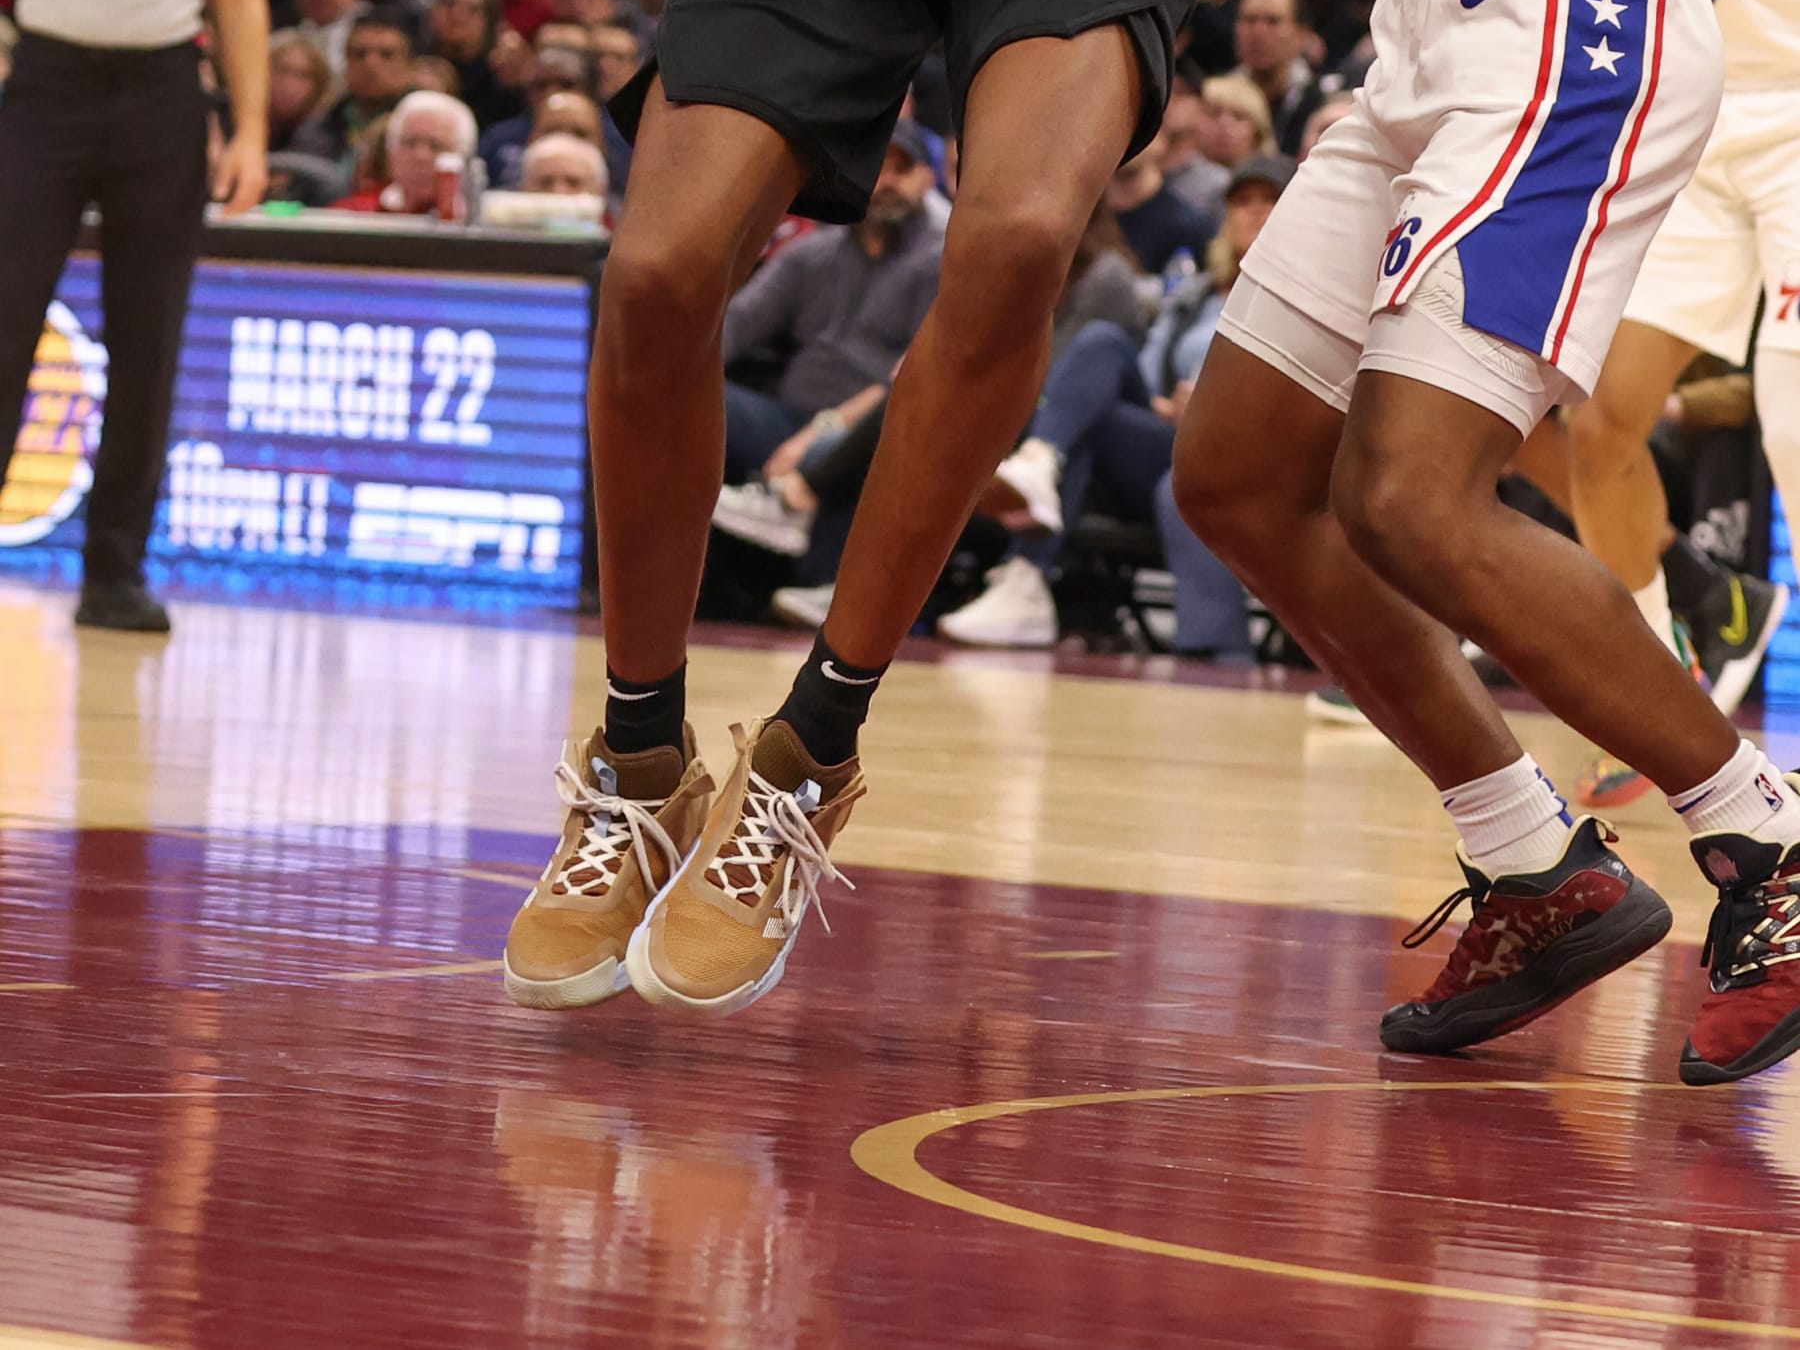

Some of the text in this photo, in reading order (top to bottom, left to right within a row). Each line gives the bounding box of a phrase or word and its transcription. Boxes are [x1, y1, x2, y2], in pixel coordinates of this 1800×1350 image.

[1776, 283, 1800, 323] 7
[228, 317, 414, 441] MARCH
[418, 327, 497, 446] 22
[347, 482, 565, 573] ESPN
